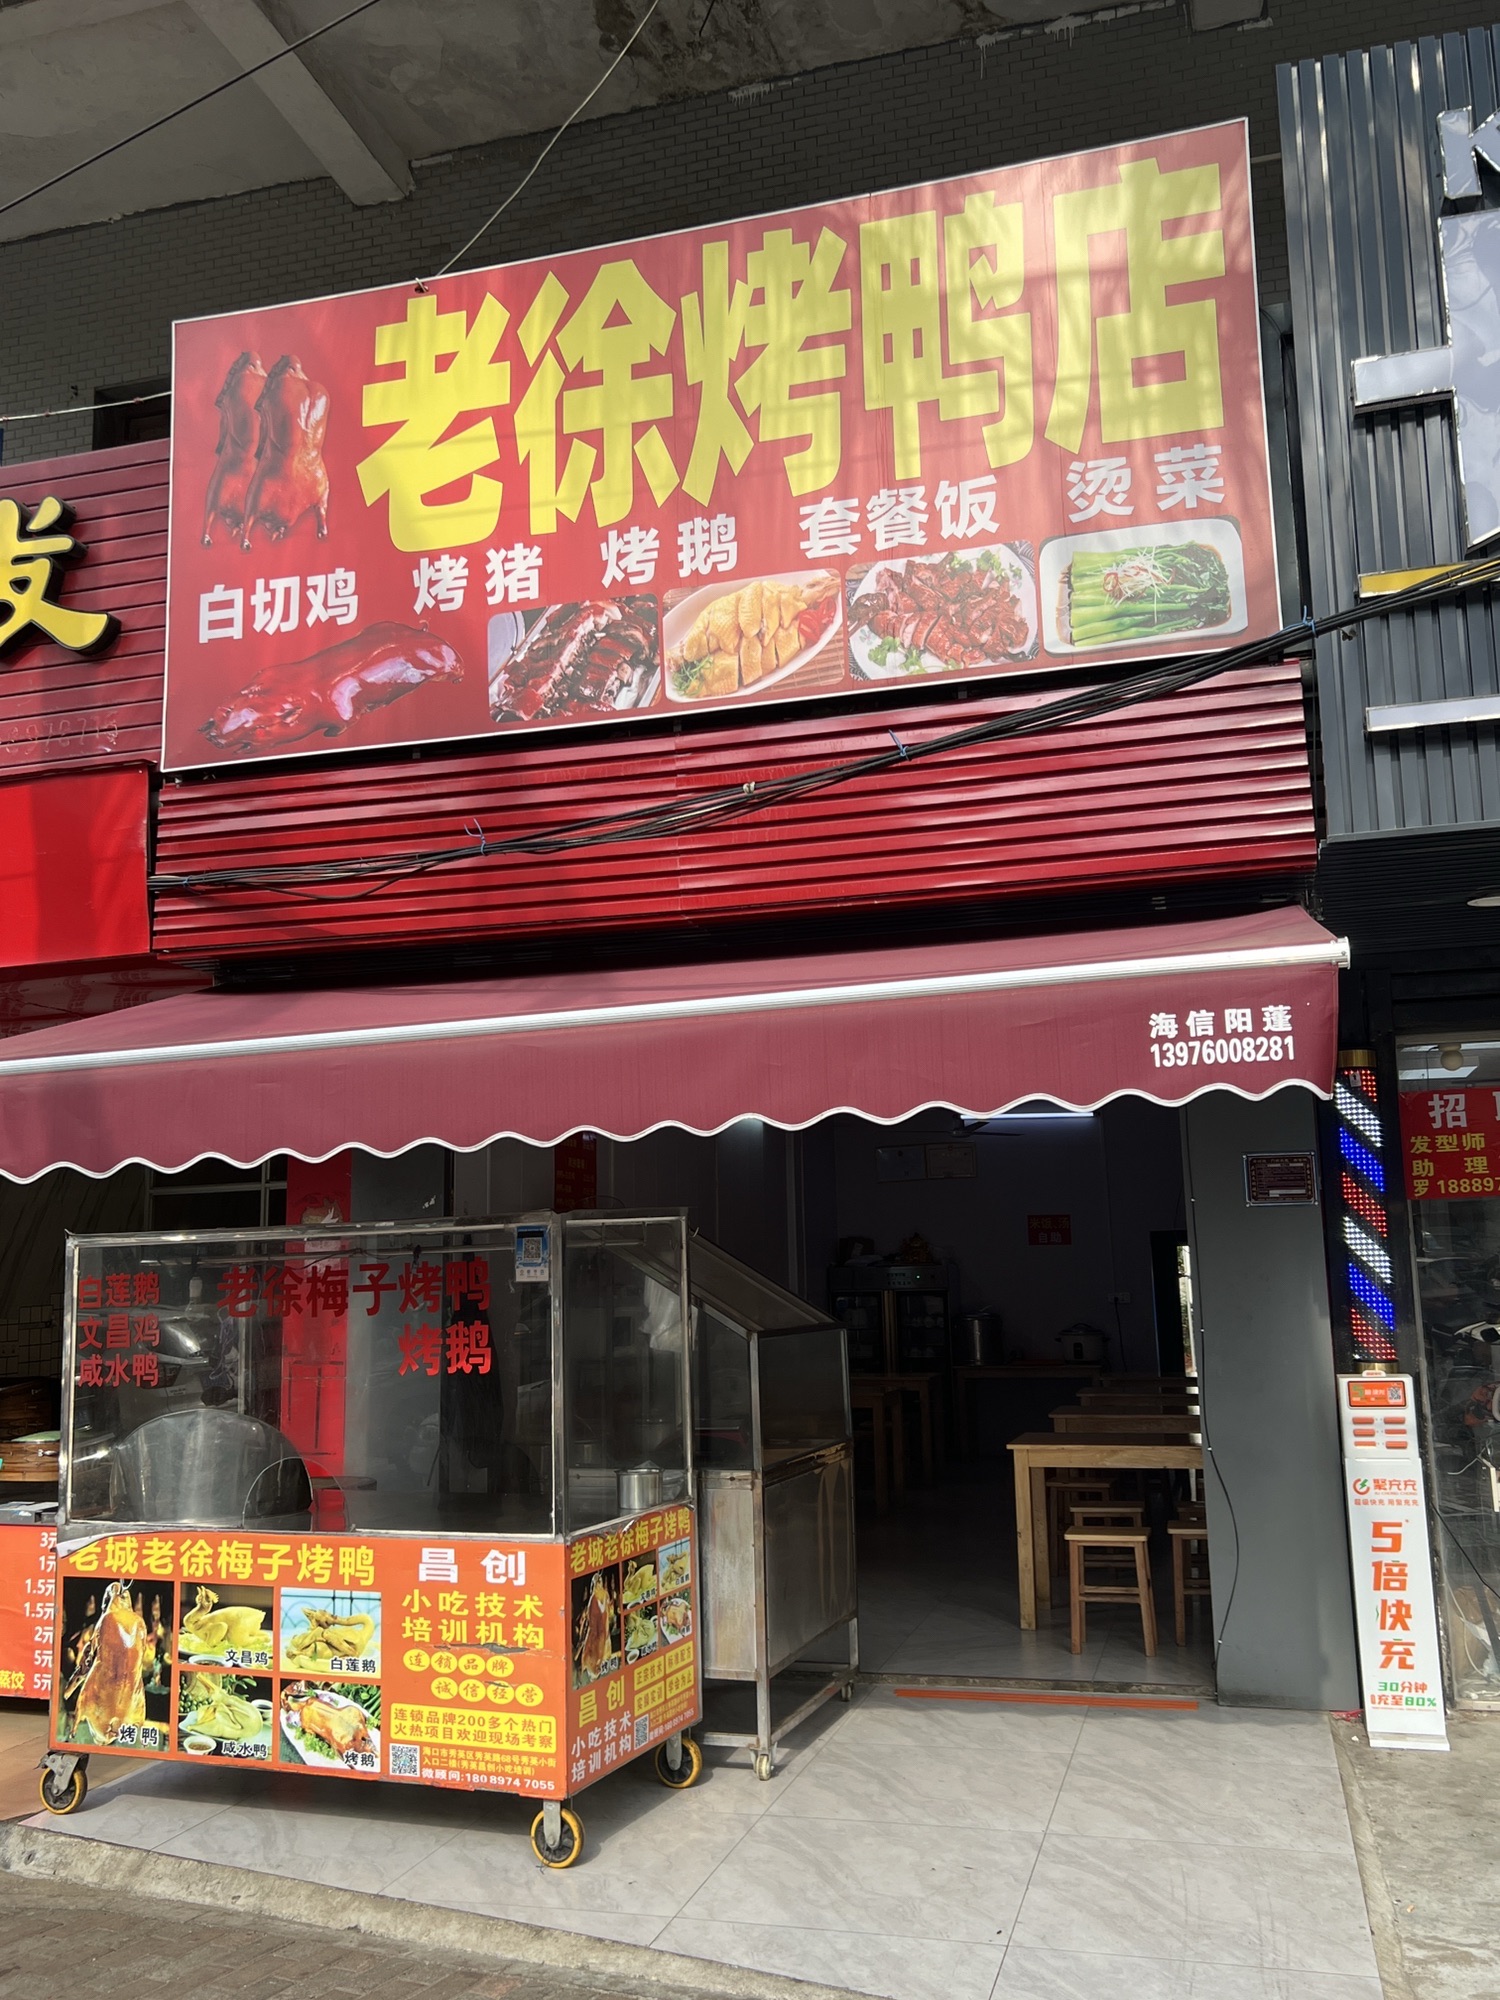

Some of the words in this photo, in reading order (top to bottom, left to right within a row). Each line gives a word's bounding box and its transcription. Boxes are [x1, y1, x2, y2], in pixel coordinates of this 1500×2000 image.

[355, 157, 1225, 552] 老徐烤鸭店
[1067, 444, 1224, 523] 烫菜
[799, 475, 999, 559] 套餐饭
[600, 513, 738, 588] 烤鹅
[412, 542, 543, 615] 烤猪
[199, 568, 359, 643] 白切鸡
[1150, 1035, 1295, 1068] 13976008281
[1410, 1133, 1485, 1154] 发型师
[1412, 1156, 1489, 1177] 助理
[1413, 1179, 1429, 1197] 罗
[78, 1271, 160, 1310] 白莲鹅
[216, 1256, 491, 1318] 老徐梅子烤鸭
[79, 1313, 160, 1350] 文昌鸡
[398, 1320, 491, 1376] 烤鹅
[77, 1352, 159, 1388] 咸水鸭
[570, 1507, 690, 1573] 老城老徐梅子烤鸭
[68, 1537, 375, 1586] 老城老徐梅子烤鸭
[418, 1547, 526, 1586] 昌创
[25, 1578, 55, 1597] 1.5元
[1371, 1521, 1416, 1670] 5倍快充
[24, 1602, 54, 1620] 1.5元
[402, 1589, 544, 1620] 小吃技术
[34, 1626, 53, 1644] 2元
[401, 1616, 544, 1650] 培训机构
[34, 1650, 53, 1668] 5元
[225, 1650, 269, 1666] 文昌鸡
[330, 1657, 376, 1673] 白莲鹅
[409, 1652, 508, 1674] 连锁品牌
[33, 1673, 51, 1691] 5元
[435, 1681, 537, 1703] 诚信经营
[1378, 1681, 1428, 1694] 30分钟
[579, 1675, 625, 1728] 昌创
[1377, 1694, 1436, 1707] 充至80%
[120, 1725, 158, 1745] 烤鸭
[393, 1708, 552, 1734] 连锁品牌200多个热门
[394, 1723, 553, 1749] 火热项目欢迎现场考察
[571, 1710, 632, 1757] 小吃技术
[222, 1742, 268, 1757] 咸水鸭
[344, 1751, 375, 1767] 烤鹅
[571, 1734, 632, 1783] 培训机构
[490, 1775, 521, 1787] 8974
[524, 1778, 555, 1790] 7055
